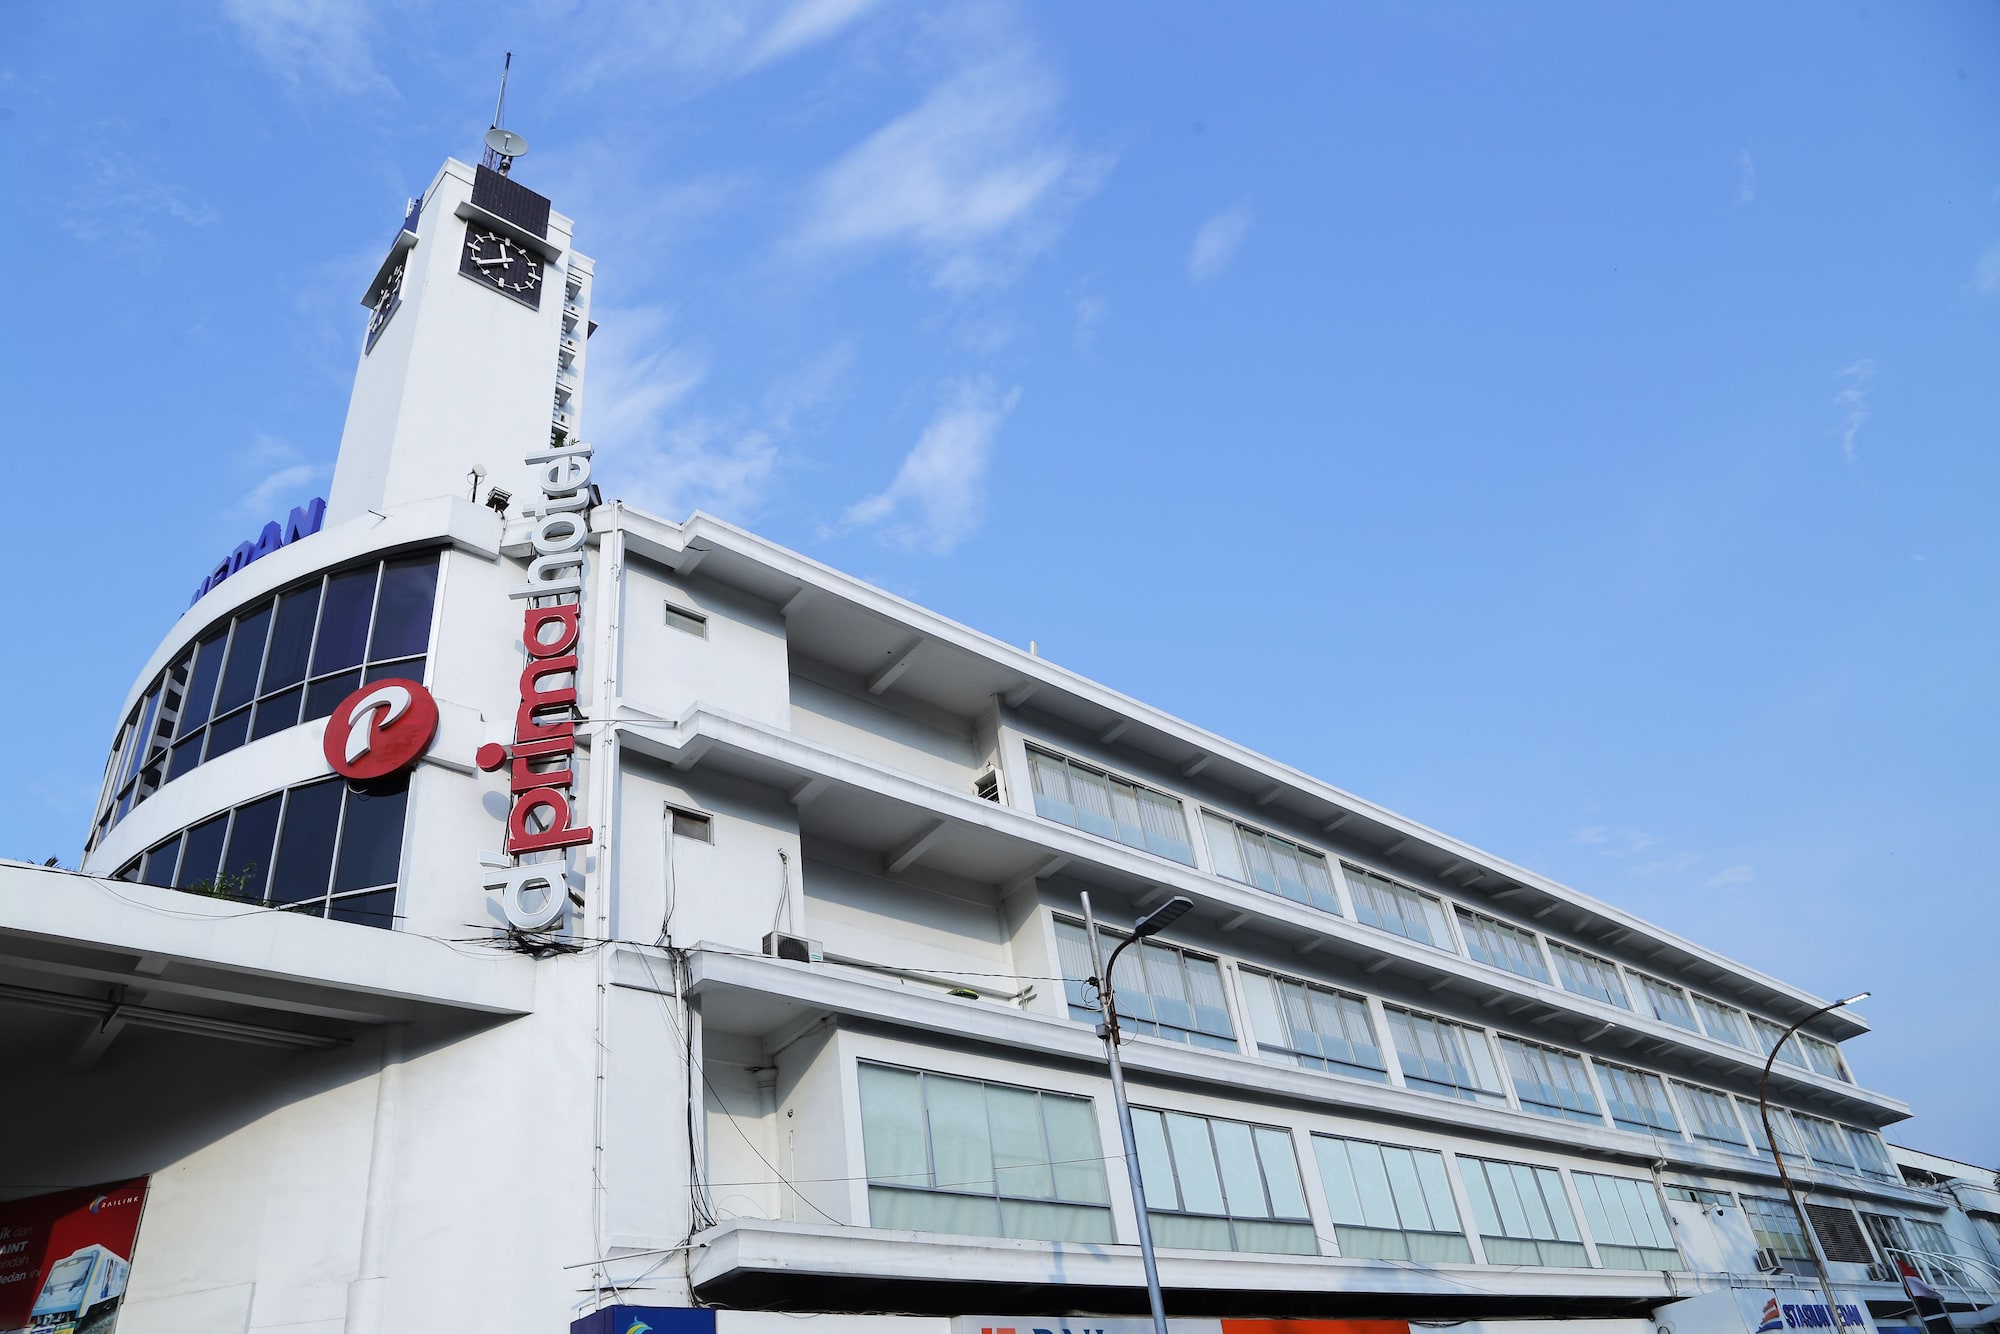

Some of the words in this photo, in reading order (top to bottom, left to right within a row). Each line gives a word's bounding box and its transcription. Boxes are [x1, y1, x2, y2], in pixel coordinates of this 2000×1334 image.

[508, 442, 593, 599] hotel
[101, 1195, 139, 1209] RAILINK
[0, 1226, 12, 1240] ik
[0, 1240, 29, 1255] AINT
[0, 1271, 27, 1284] edan
[1782, 1304, 1831, 1328] STASIUN
